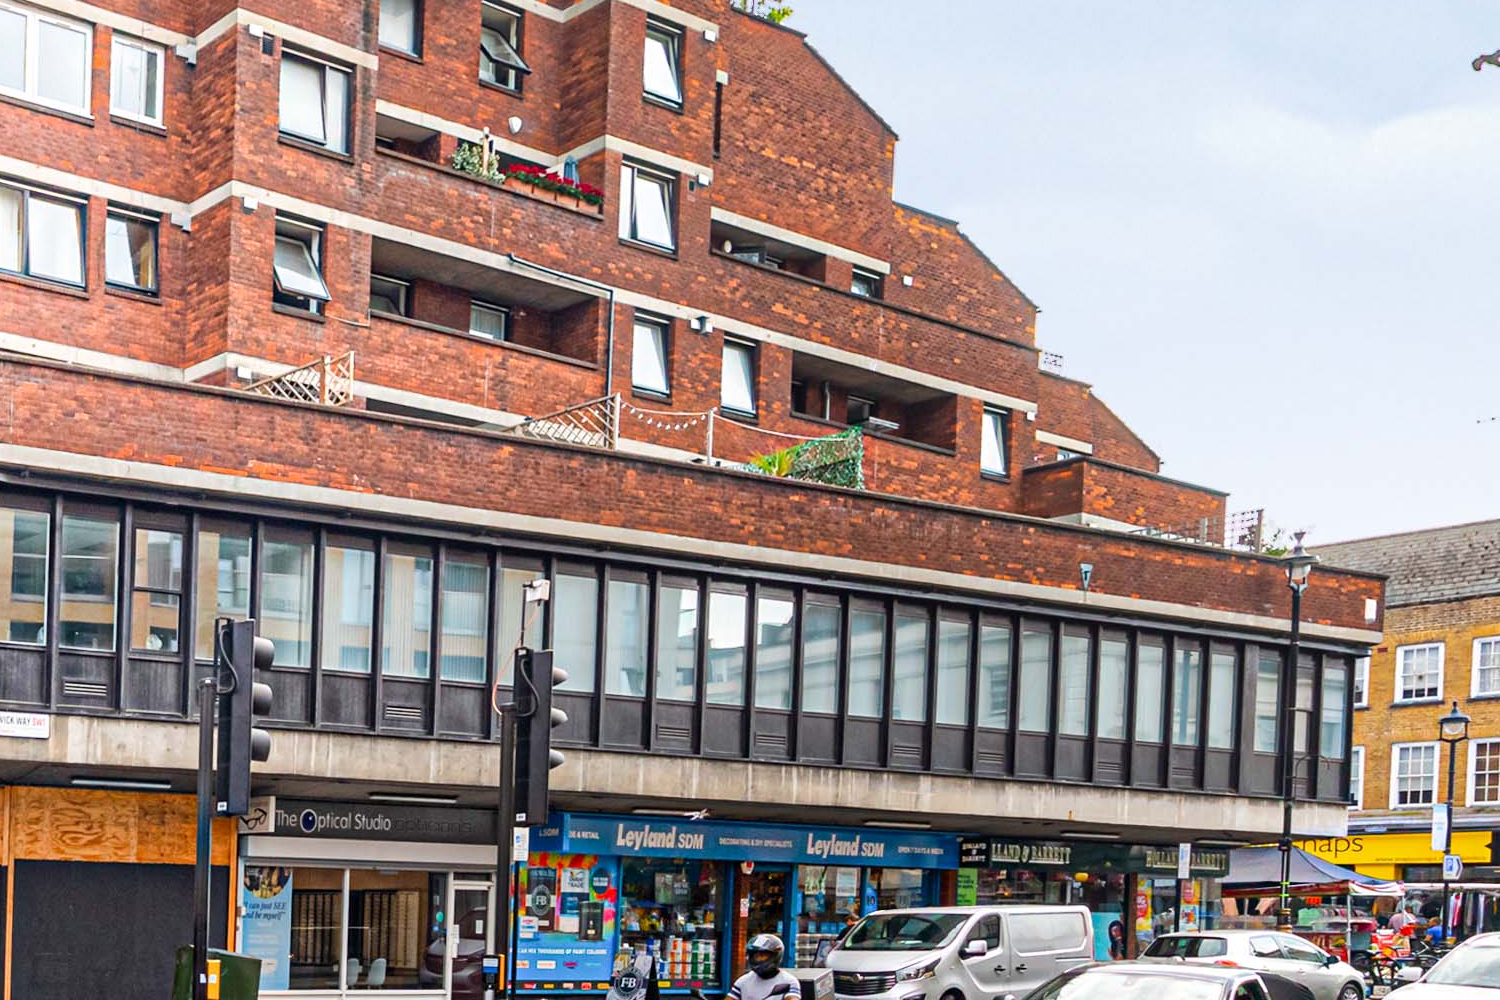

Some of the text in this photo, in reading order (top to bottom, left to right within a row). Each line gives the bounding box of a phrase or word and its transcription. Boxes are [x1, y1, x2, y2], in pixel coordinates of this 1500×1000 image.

[16, 716, 31, 726] WAY
[32, 717, 45, 727] SW1
[275, 808, 392, 833] The Optical Studio
[616, 823, 704, 851] Leyland SDM
[806, 832, 885, 859] Leyland SDM
[1302, 836, 1364, 858] naps
[991, 843, 1021, 862] LLAND
[1030, 845, 1071, 864] BARRETT
[1146, 850, 1178, 868] HOLLAN
